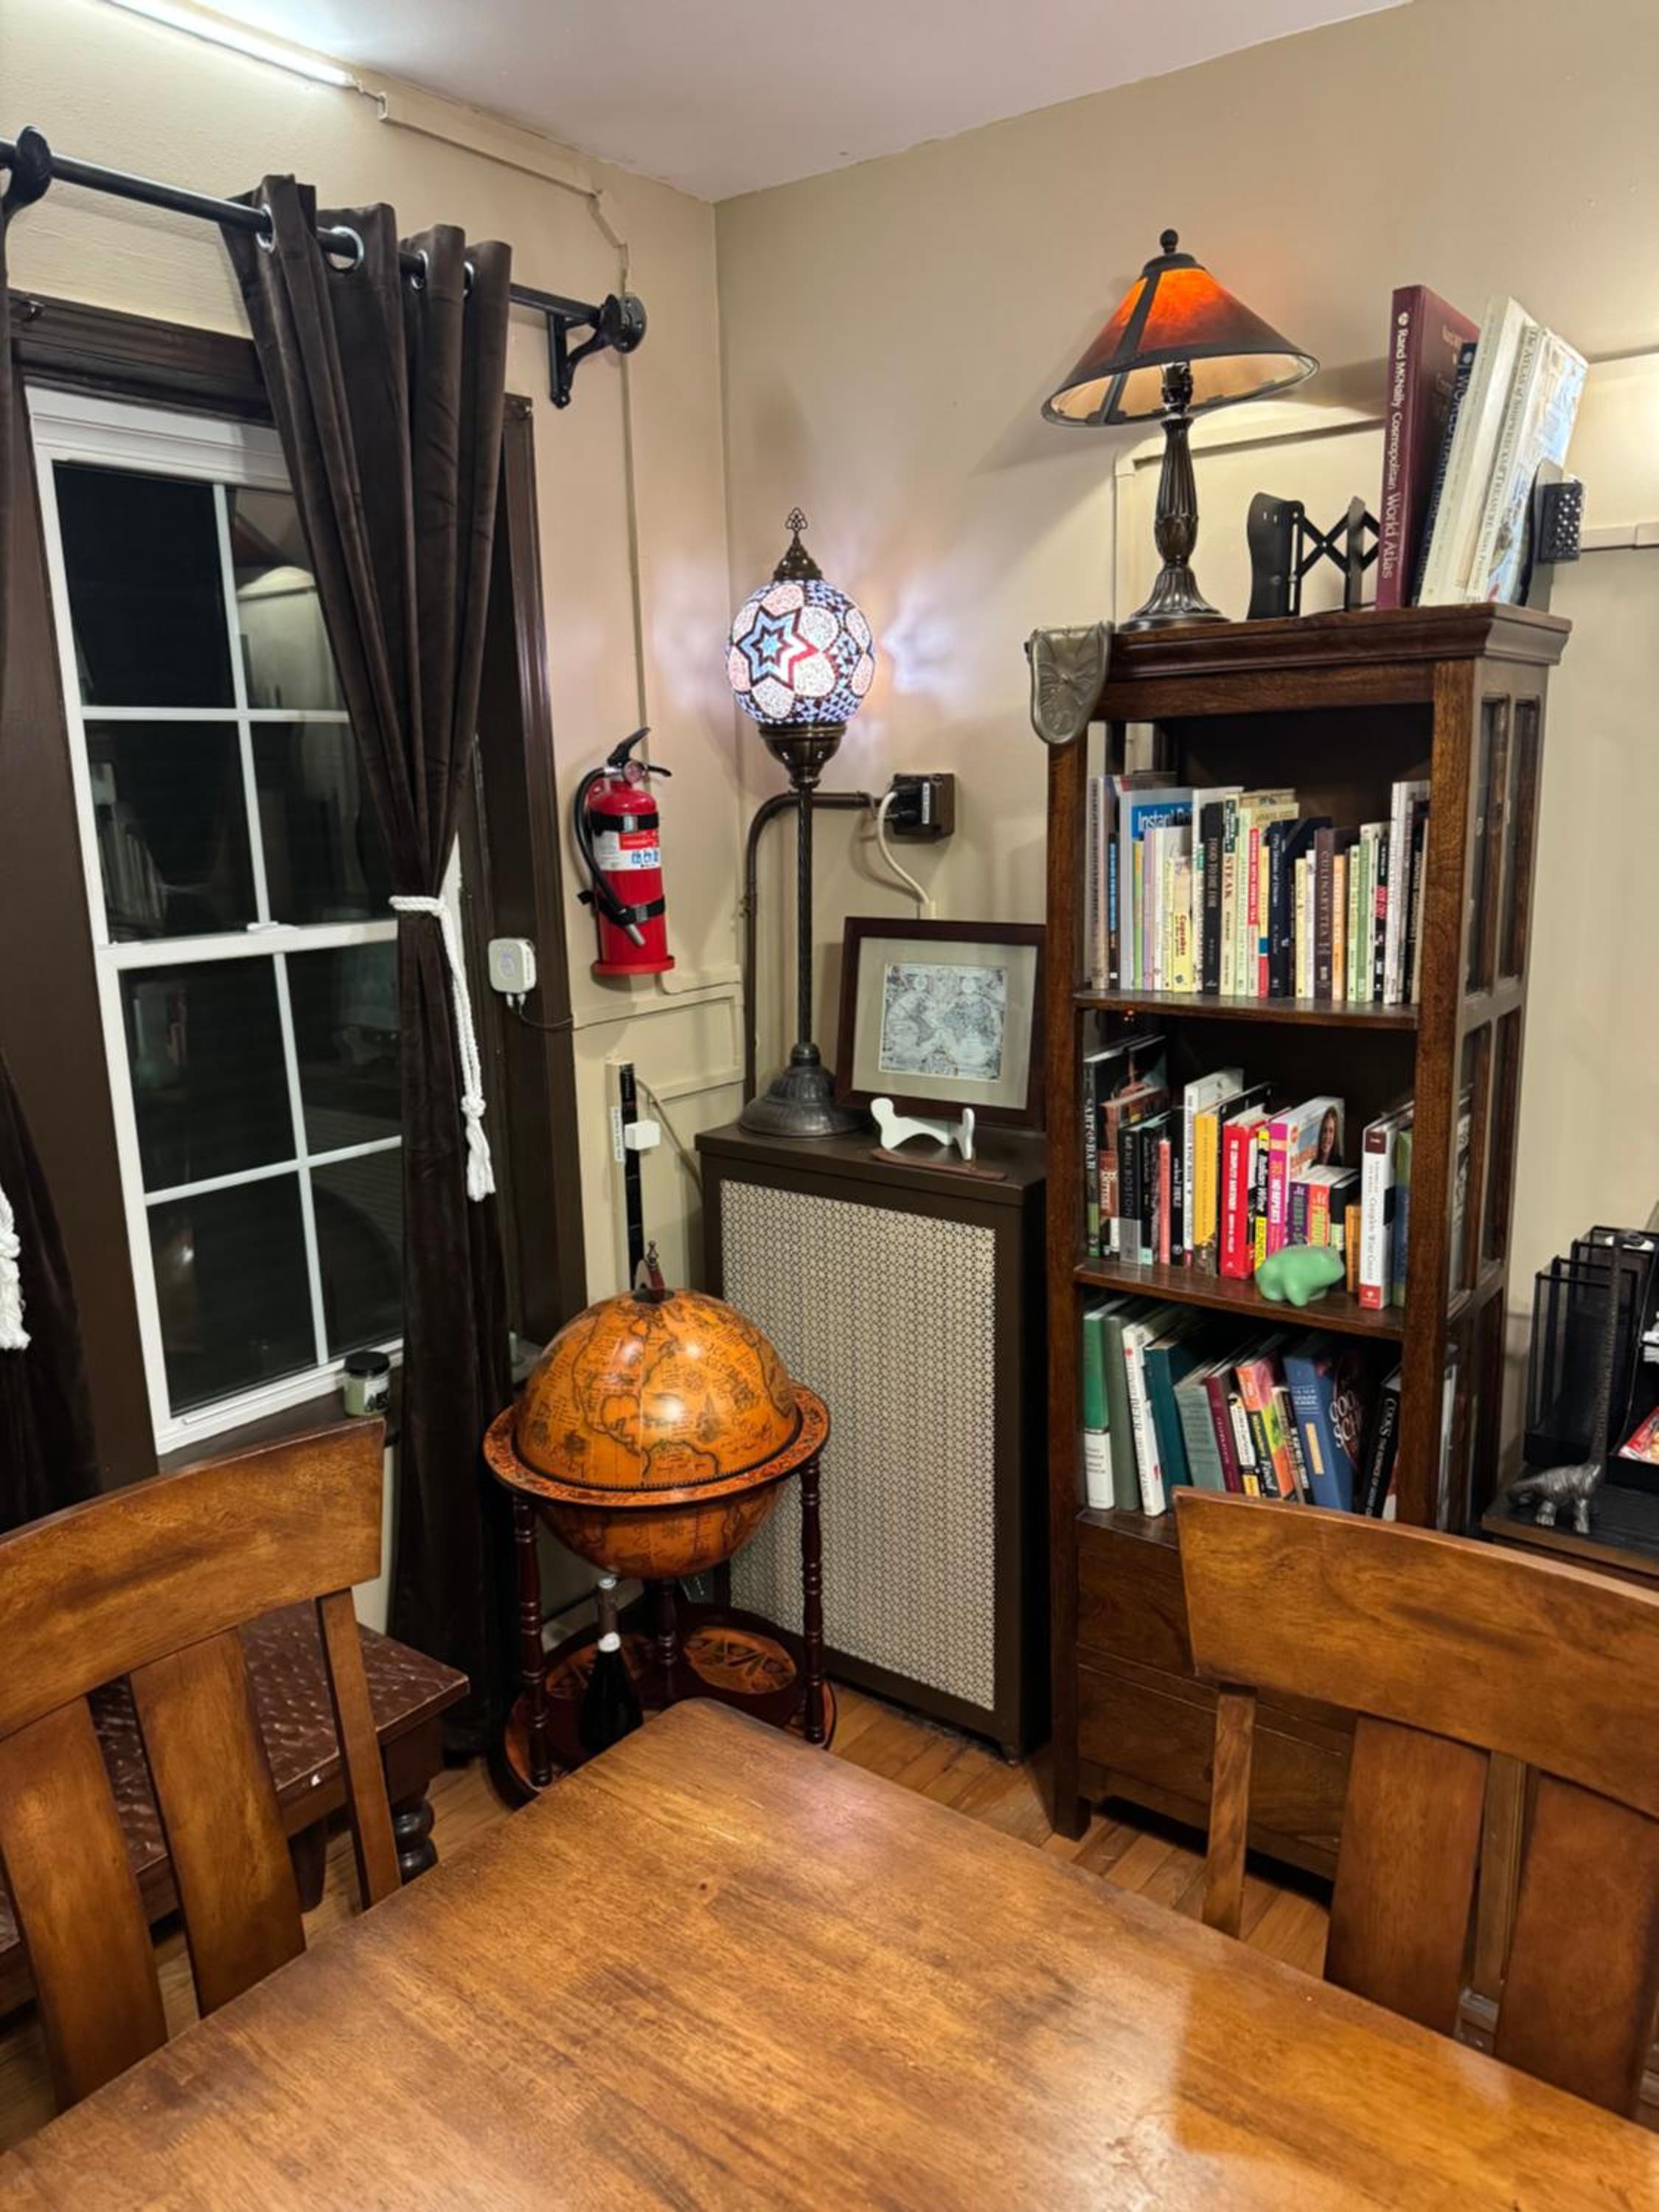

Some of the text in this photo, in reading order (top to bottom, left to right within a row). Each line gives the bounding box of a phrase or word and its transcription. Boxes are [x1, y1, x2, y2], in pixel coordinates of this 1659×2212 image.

[1528, 330, 1538, 346] The
[1382, 328, 1408, 579] Rand McNally Cosmopolitan World Atlas
[1208, 838, 1218, 861] FOOD
[1224, 857, 1234, 899] STEAK
[1321, 851, 1330, 937] CULINARY TEA
[1179, 915, 1188, 956] Cupcakes
[1085, 1106, 1097, 1169] ART BAR
[1258, 1155, 1268, 1186] Italian
[1124, 1169, 1133, 1217] BOSTON
[1257, 1187, 1267, 1212] Wine
[1312, 1206, 1327, 1247] PRODU
[1366, 1197, 1379, 1279] Complete Wine Course
